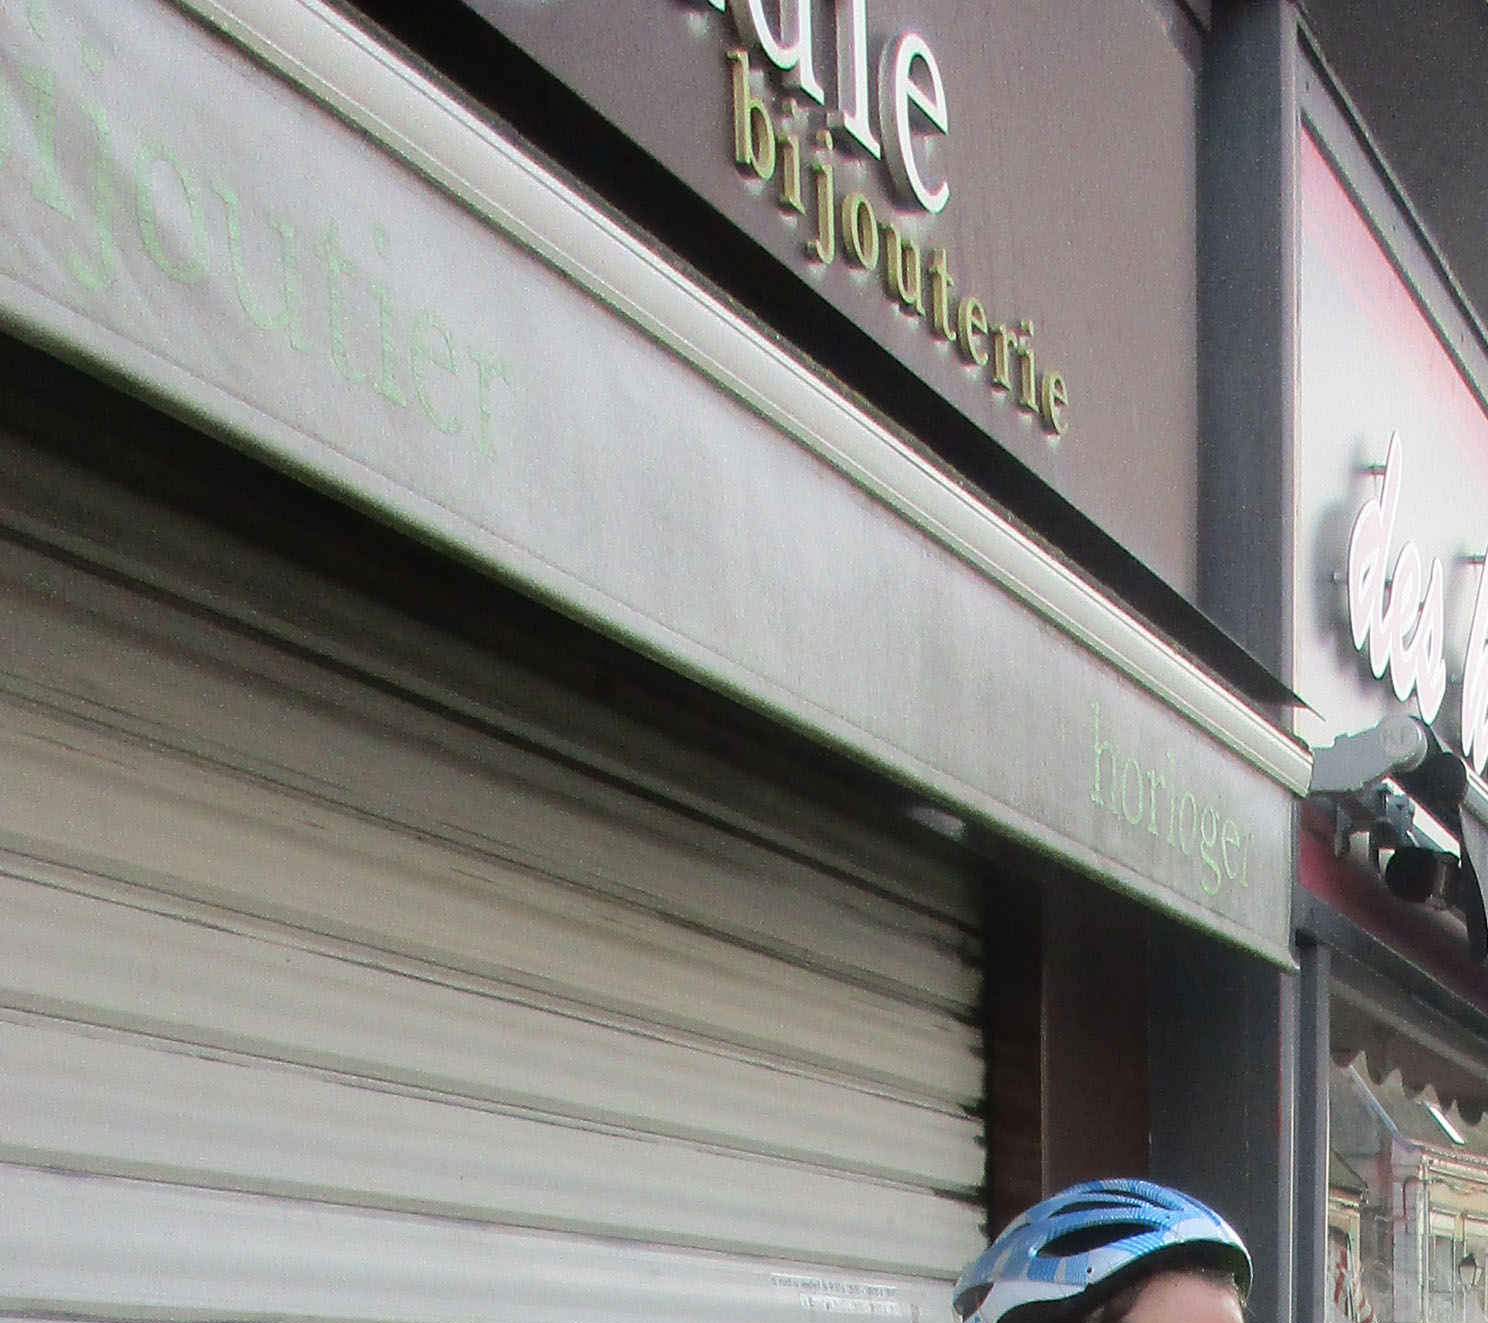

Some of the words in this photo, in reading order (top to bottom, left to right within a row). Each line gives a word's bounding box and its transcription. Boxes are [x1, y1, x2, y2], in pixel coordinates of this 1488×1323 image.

[0, 0, 511, 458] ijoutier
[707, 0, 949, 214] ule
[727, 50, 1069, 436] bijouterie
[1091, 701, 1253, 896] horloger
